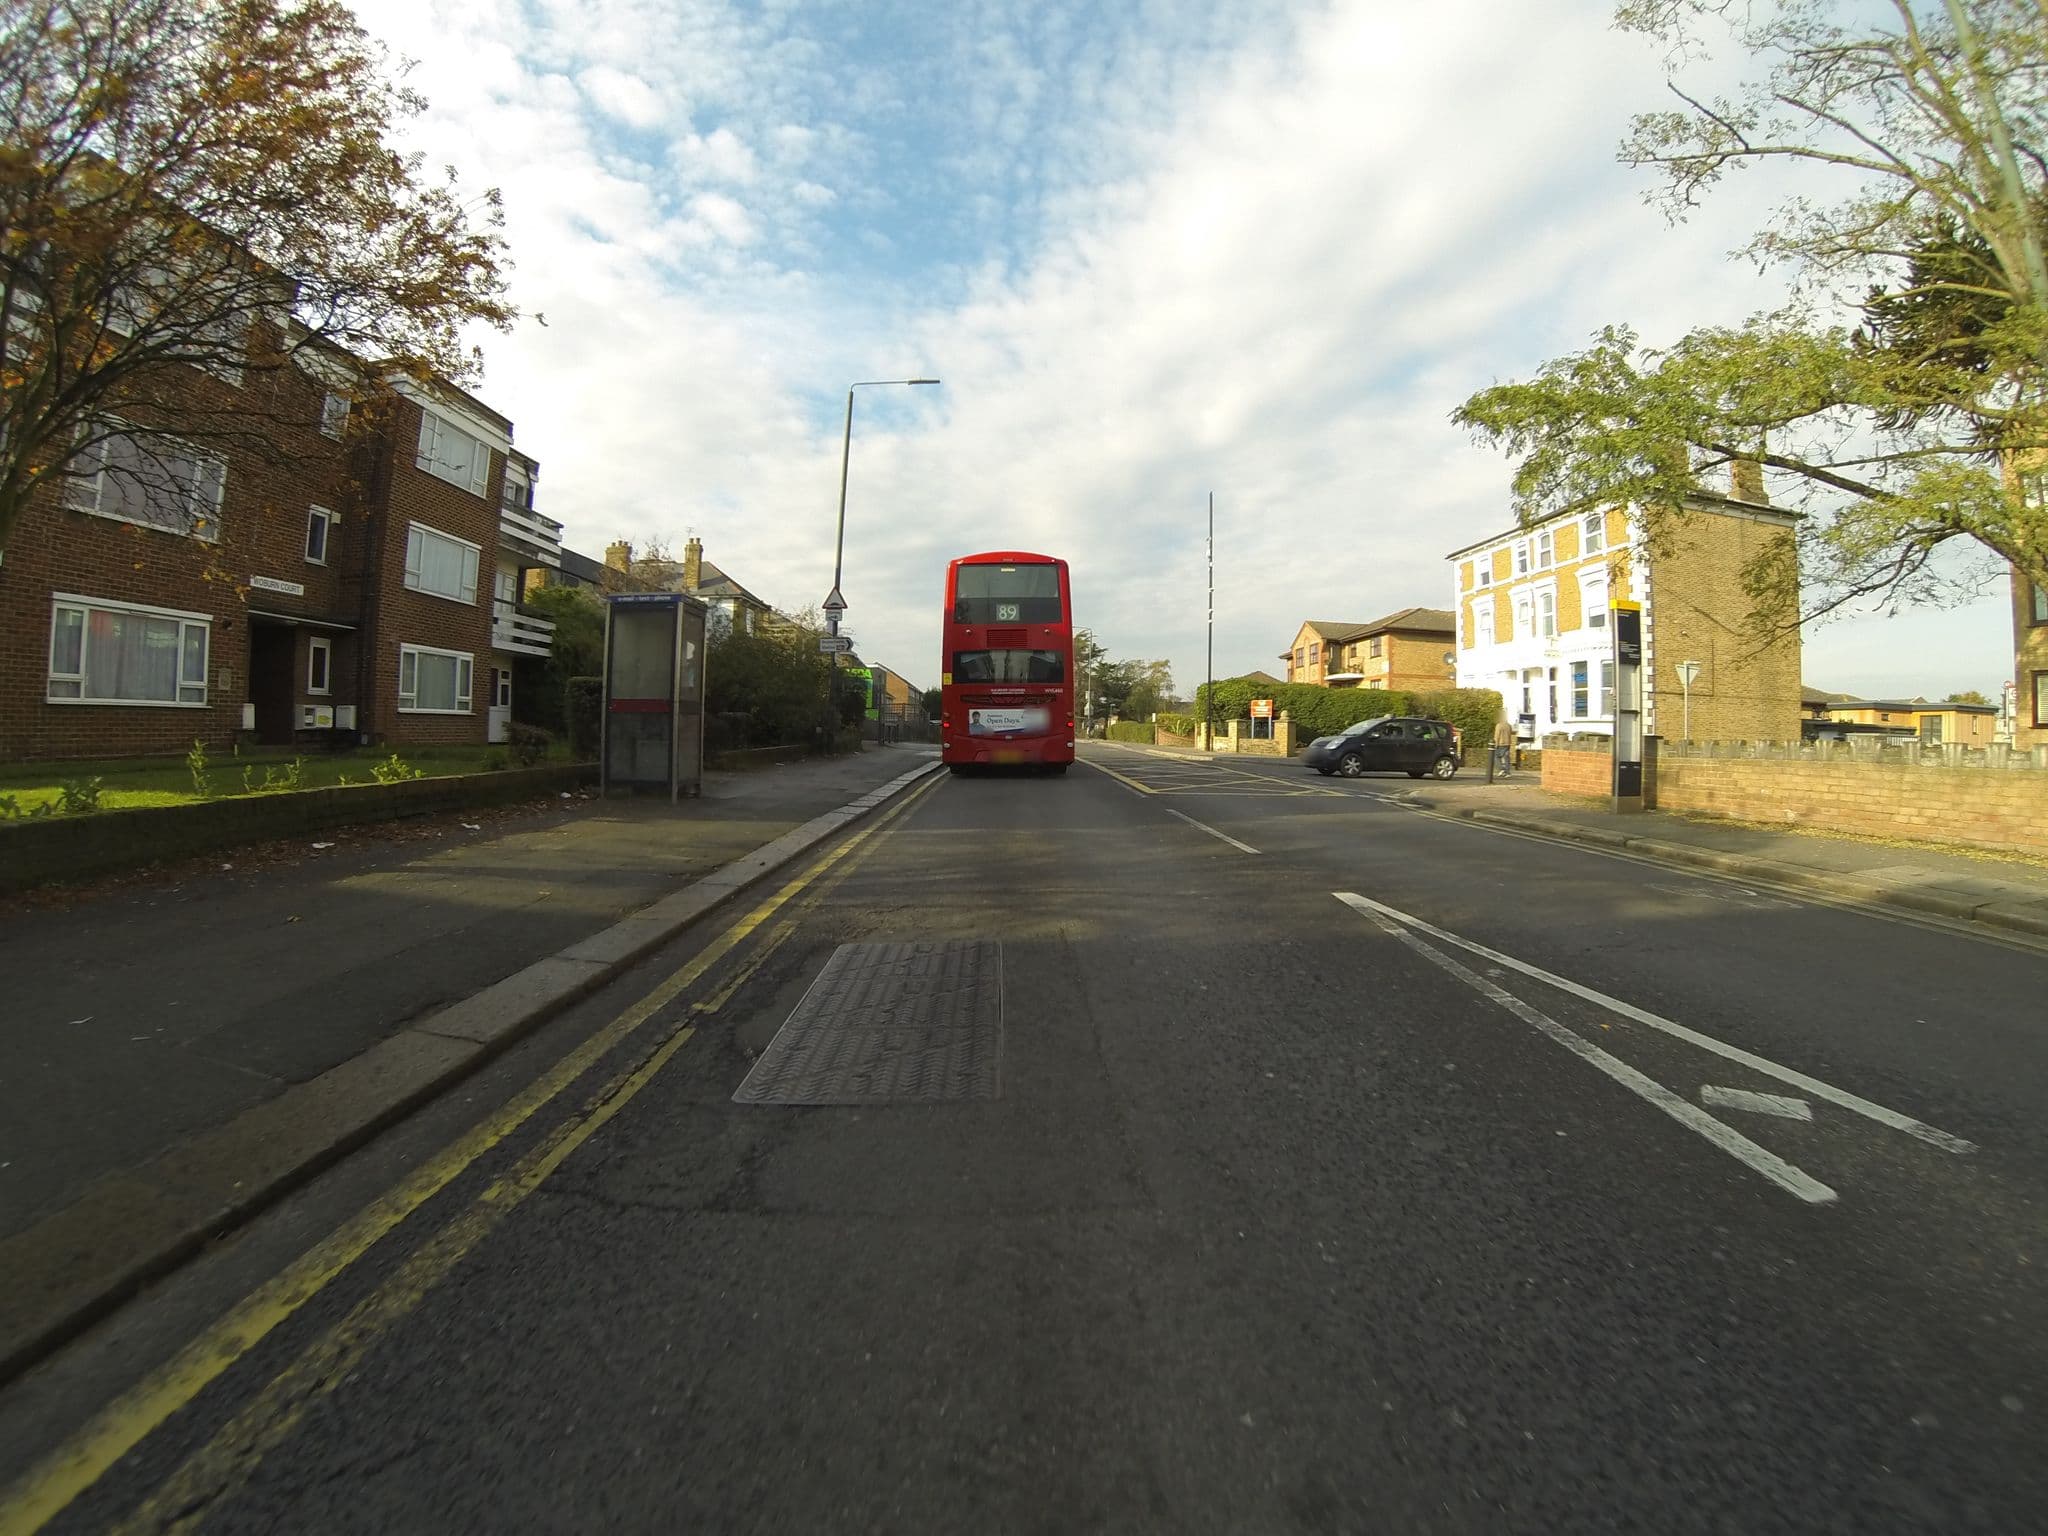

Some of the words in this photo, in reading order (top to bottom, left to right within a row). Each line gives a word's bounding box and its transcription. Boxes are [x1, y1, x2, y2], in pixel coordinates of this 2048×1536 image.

[254, 577, 280, 589] WOBURN
[280, 583, 301, 594] COURT
[999, 605, 1017, 620] 89
